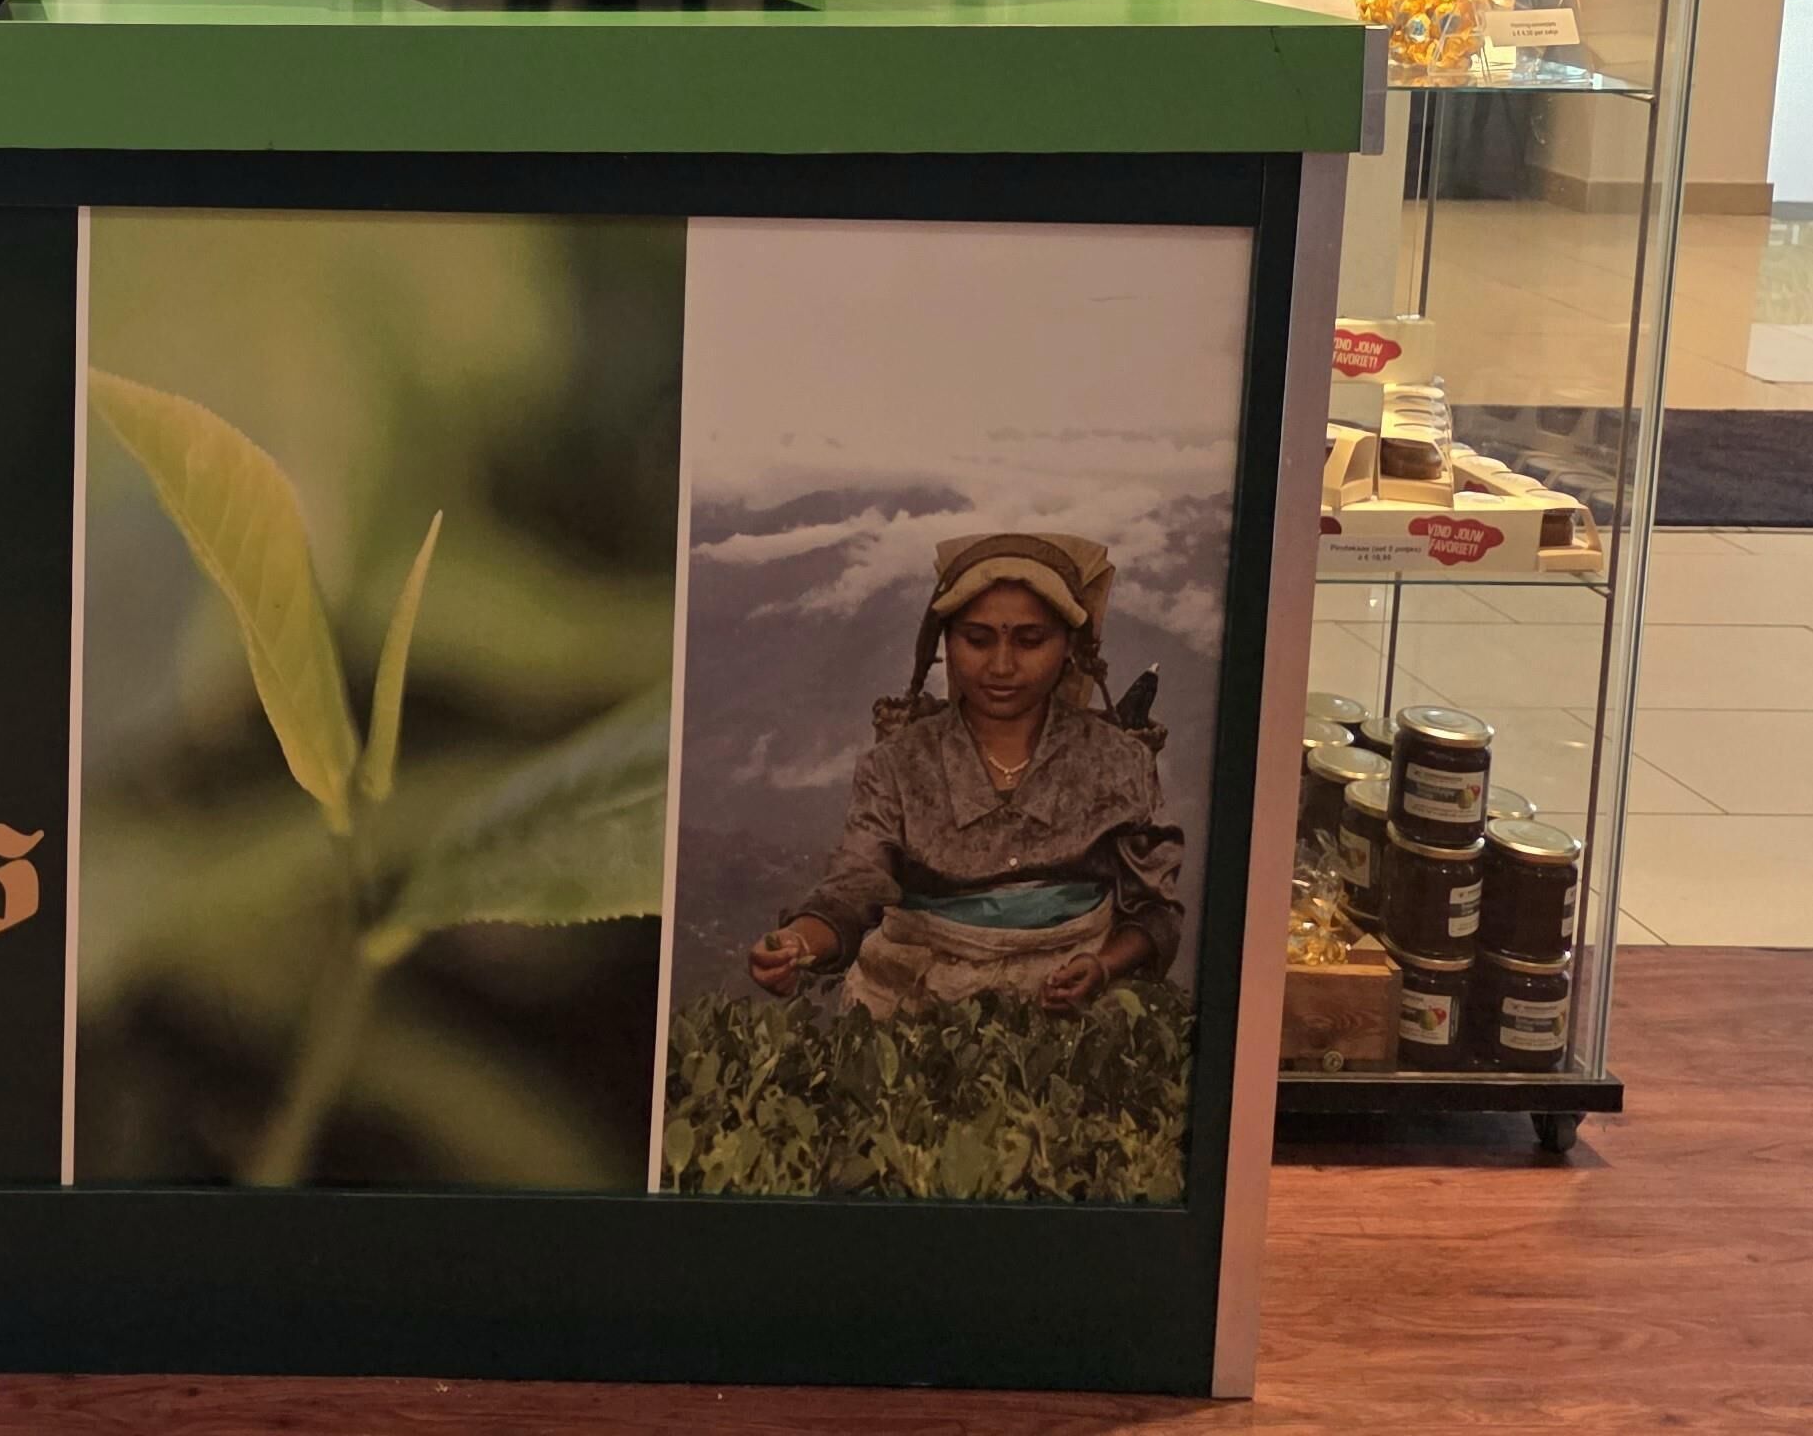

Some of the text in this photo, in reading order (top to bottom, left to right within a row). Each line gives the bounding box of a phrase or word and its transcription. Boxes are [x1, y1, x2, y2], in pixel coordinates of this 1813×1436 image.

[1354, 340, 1383, 355] JOUW
[1427, 523, 1485, 543] VIND JOUW
[1428, 538, 1479, 556] FAVORIET!
